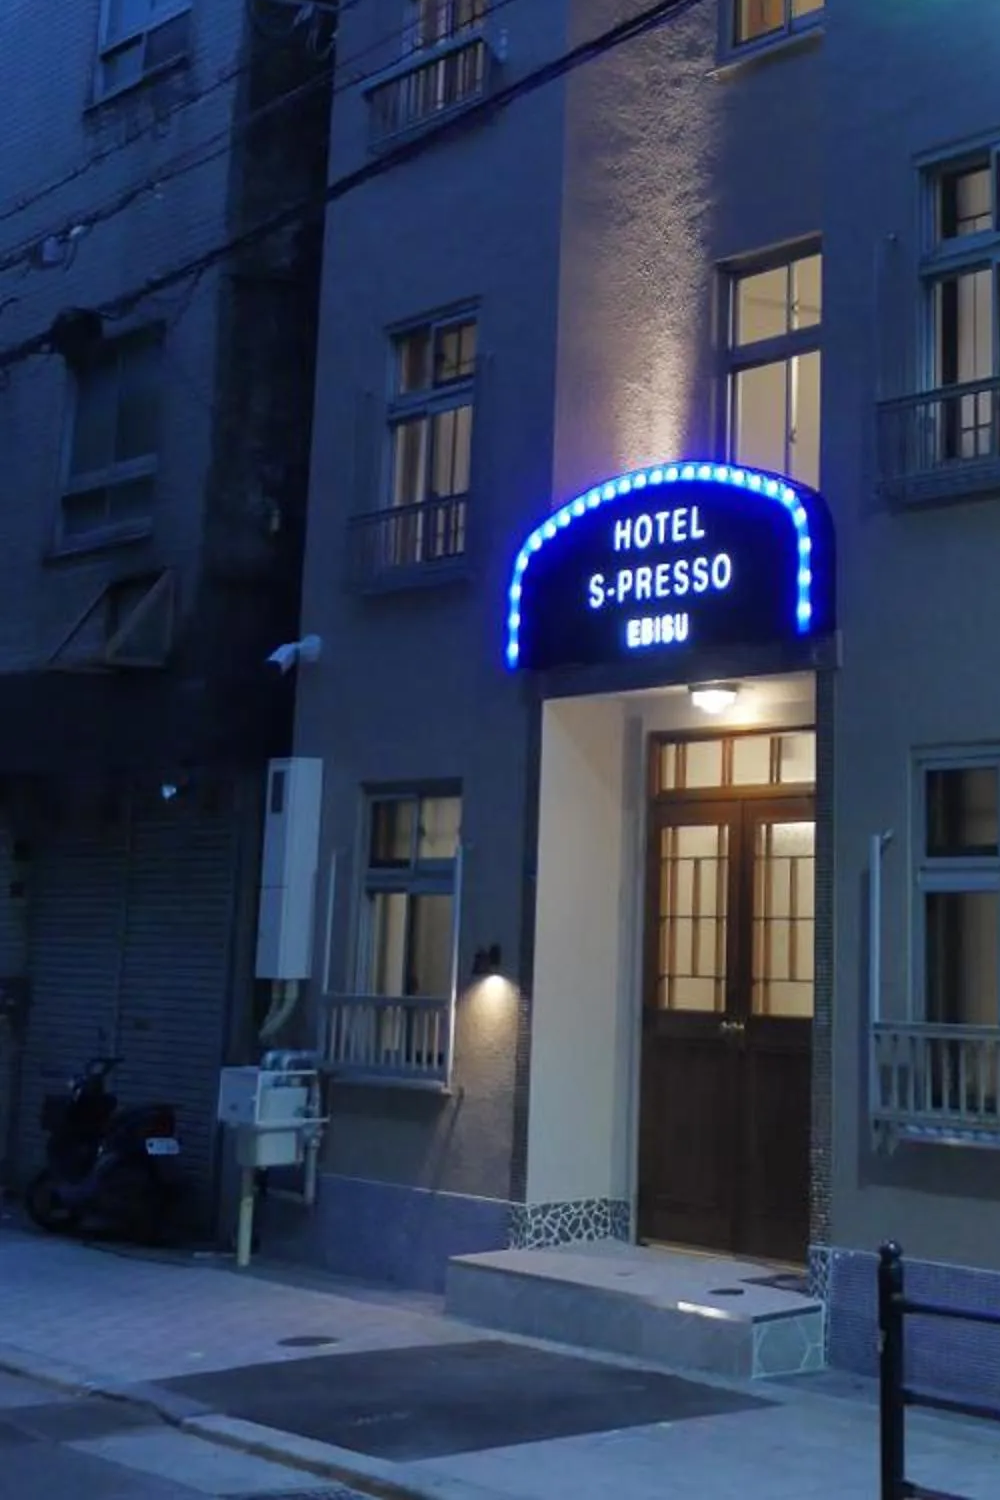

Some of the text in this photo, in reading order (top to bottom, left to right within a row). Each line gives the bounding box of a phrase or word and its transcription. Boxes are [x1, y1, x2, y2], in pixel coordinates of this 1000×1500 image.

[614, 505, 705, 551] HOTEL
[588, 553, 732, 609] S-PRESSO
[626, 612, 689, 648] EBISU
